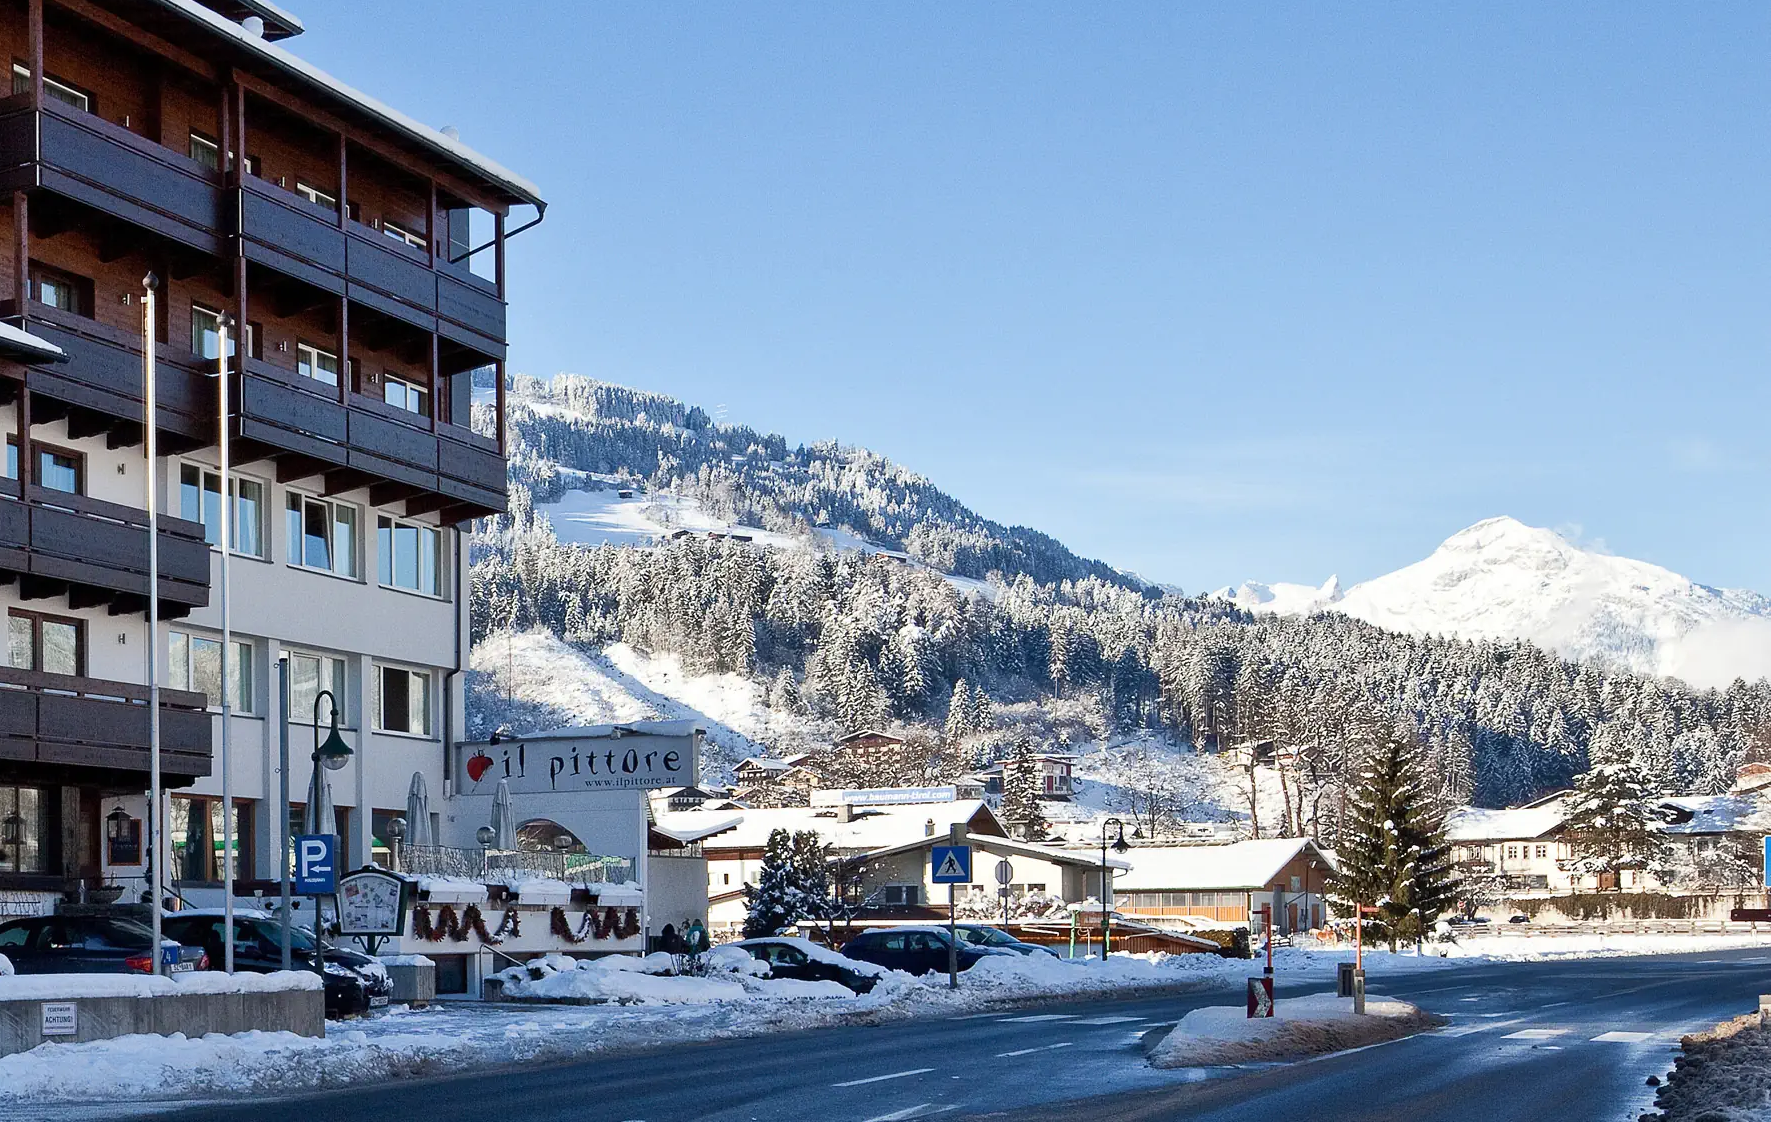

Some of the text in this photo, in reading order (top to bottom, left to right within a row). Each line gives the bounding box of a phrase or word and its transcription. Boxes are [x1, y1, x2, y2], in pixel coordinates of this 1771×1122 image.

[501, 743, 682, 791] il pittore
[584, 777, 676, 789] www.ilpittore.at
[843, 790, 951, 803] www.baumann-tirol.com
[301, 840, 327, 877] P
